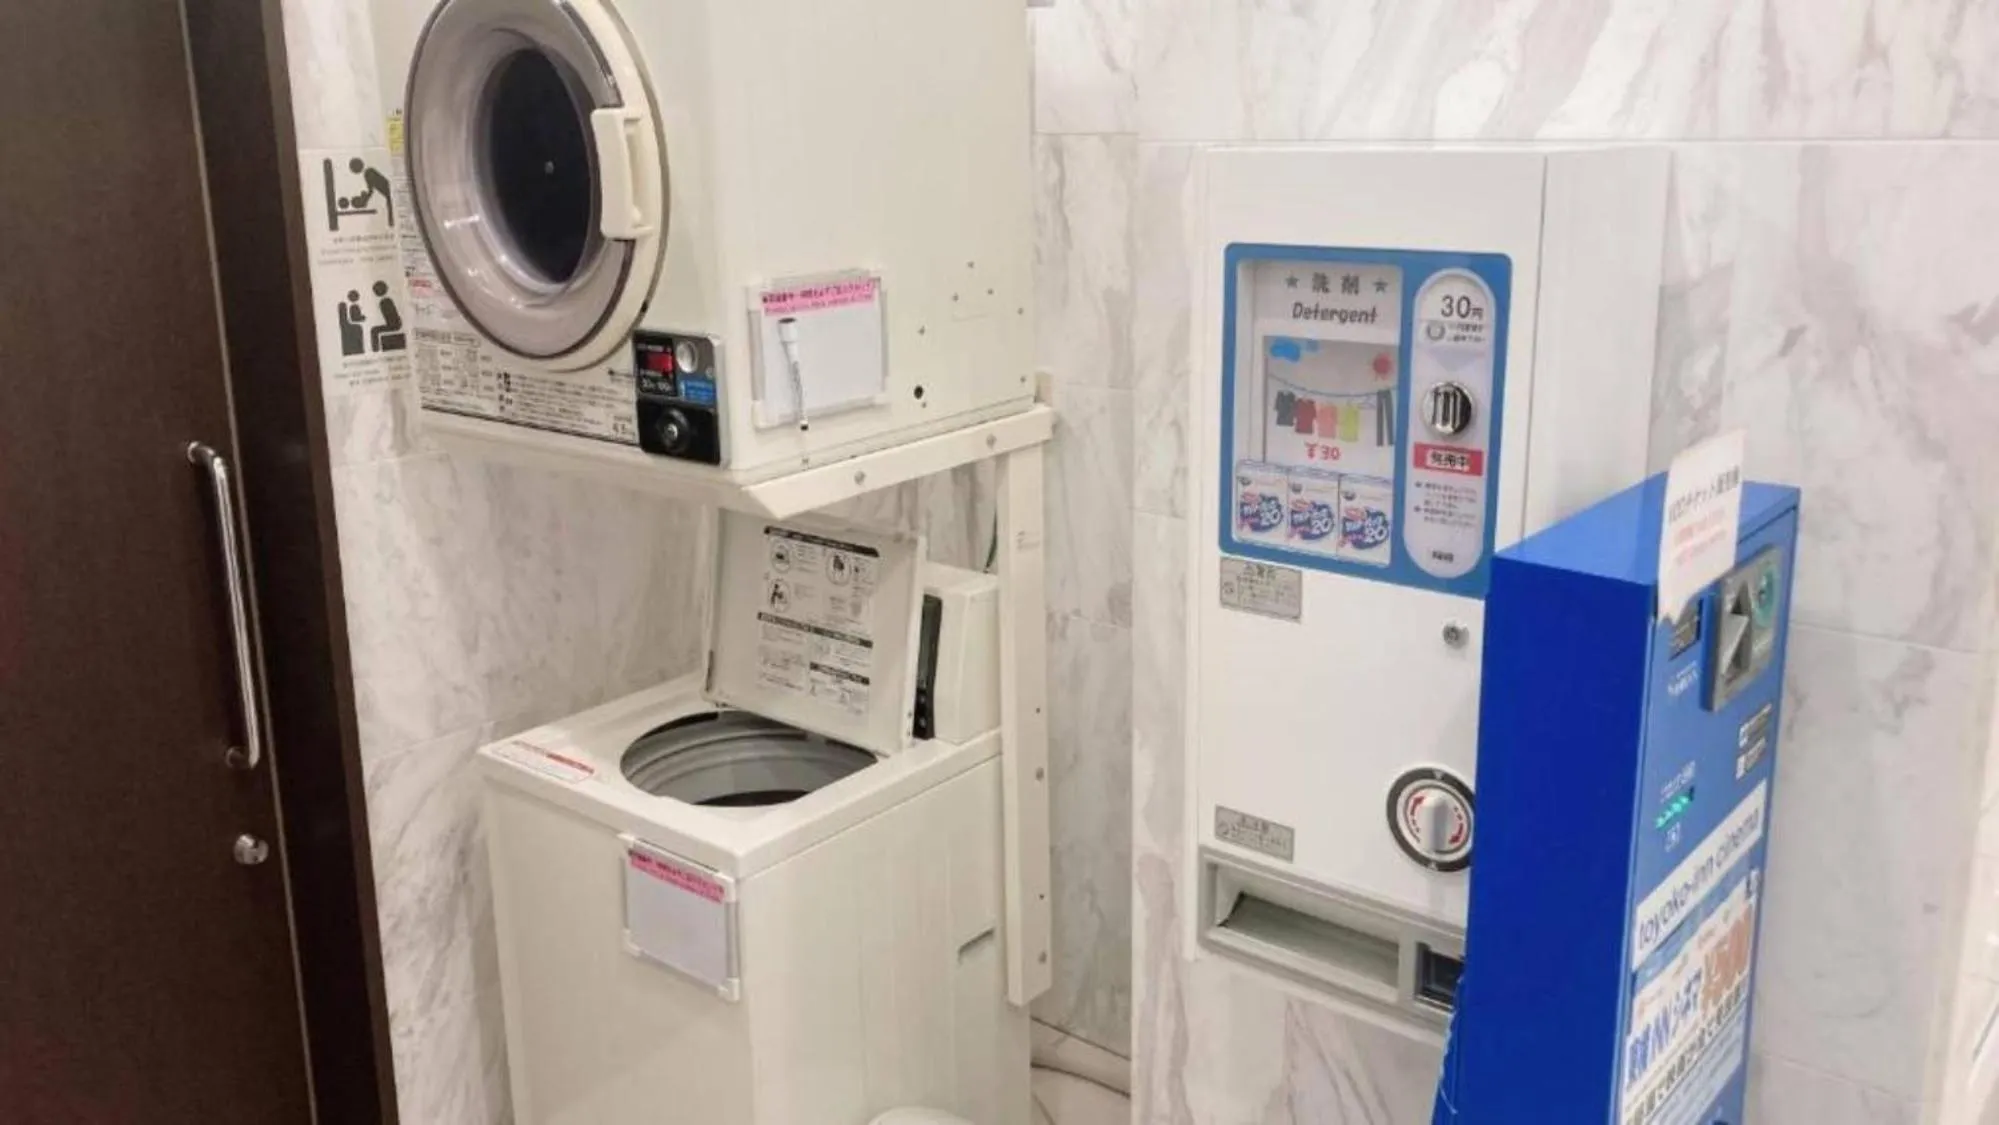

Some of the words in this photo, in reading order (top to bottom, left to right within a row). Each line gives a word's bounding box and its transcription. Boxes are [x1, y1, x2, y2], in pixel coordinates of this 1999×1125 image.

[1292, 302, 1378, 324] Detergent
[1441, 295, 1484, 319] 30円
[1639, 857, 1713, 950] toyoko-inn
[1715, 809, 1759, 869] cinema
